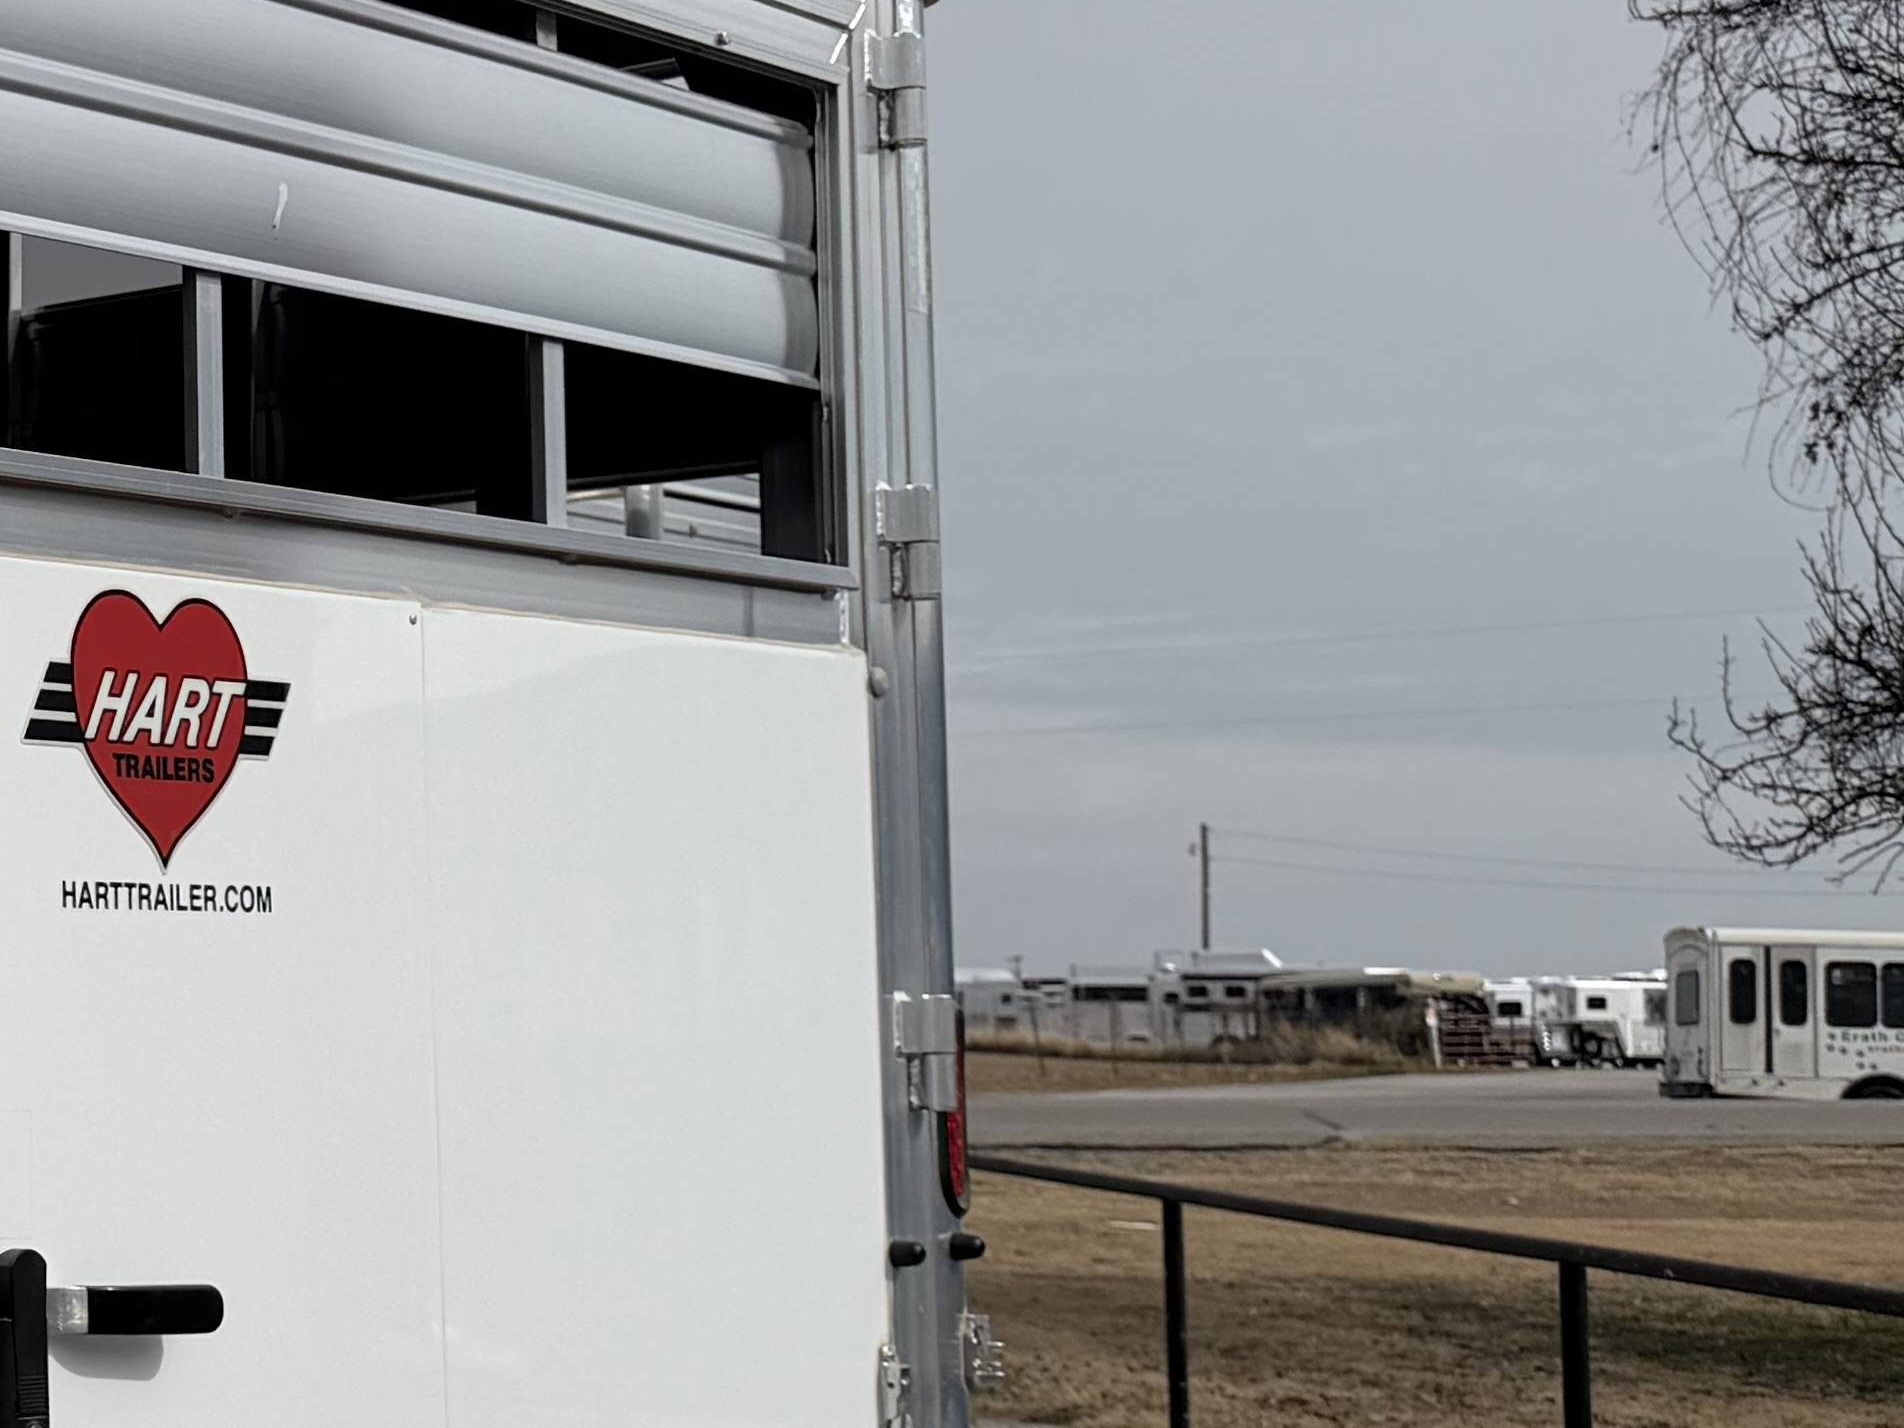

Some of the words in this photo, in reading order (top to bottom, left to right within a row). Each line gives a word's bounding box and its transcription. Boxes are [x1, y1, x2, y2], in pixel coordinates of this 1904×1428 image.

[84, 670, 247, 748] HART
[112, 753, 215, 783] TRAILERS
[62, 880, 273, 913] HARTTRAILER.COM
